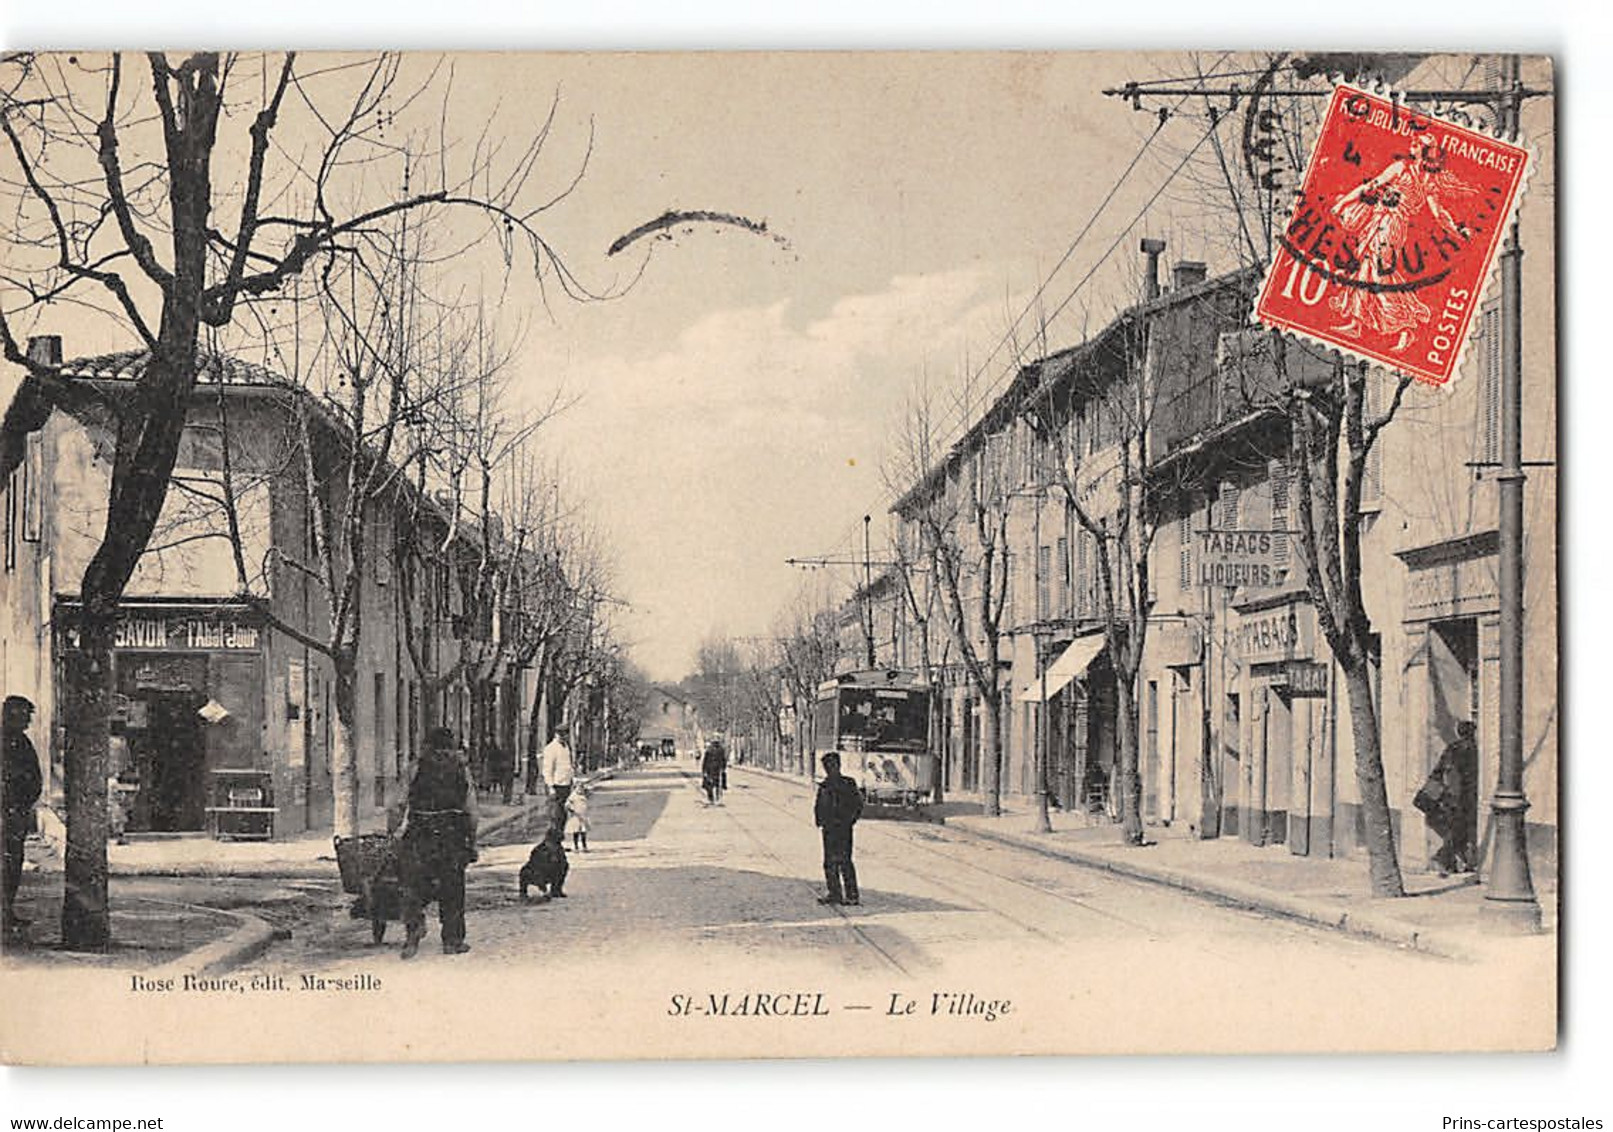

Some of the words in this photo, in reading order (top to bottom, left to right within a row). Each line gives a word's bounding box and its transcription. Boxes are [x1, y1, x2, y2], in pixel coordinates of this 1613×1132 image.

[1441, 134, 1517, 174] FRANÇAISE
[1427, 287, 1469, 365] POSTES
[1202, 532, 1271, 555] TABACS
[1202, 562, 1271, 586] LIQUEURS
[114, 619, 167, 648] SAVON
[131, 974, 175, 992] Rose
[183, 974, 245, 994] Roure,
[250, 974, 291, 992] édit.
[300, 974, 382, 992] Marseille
[667, 993, 831, 1017] St-MARCEL
[885, 993, 917, 1017] Le
[930, 993, 1012, 1022] Village
